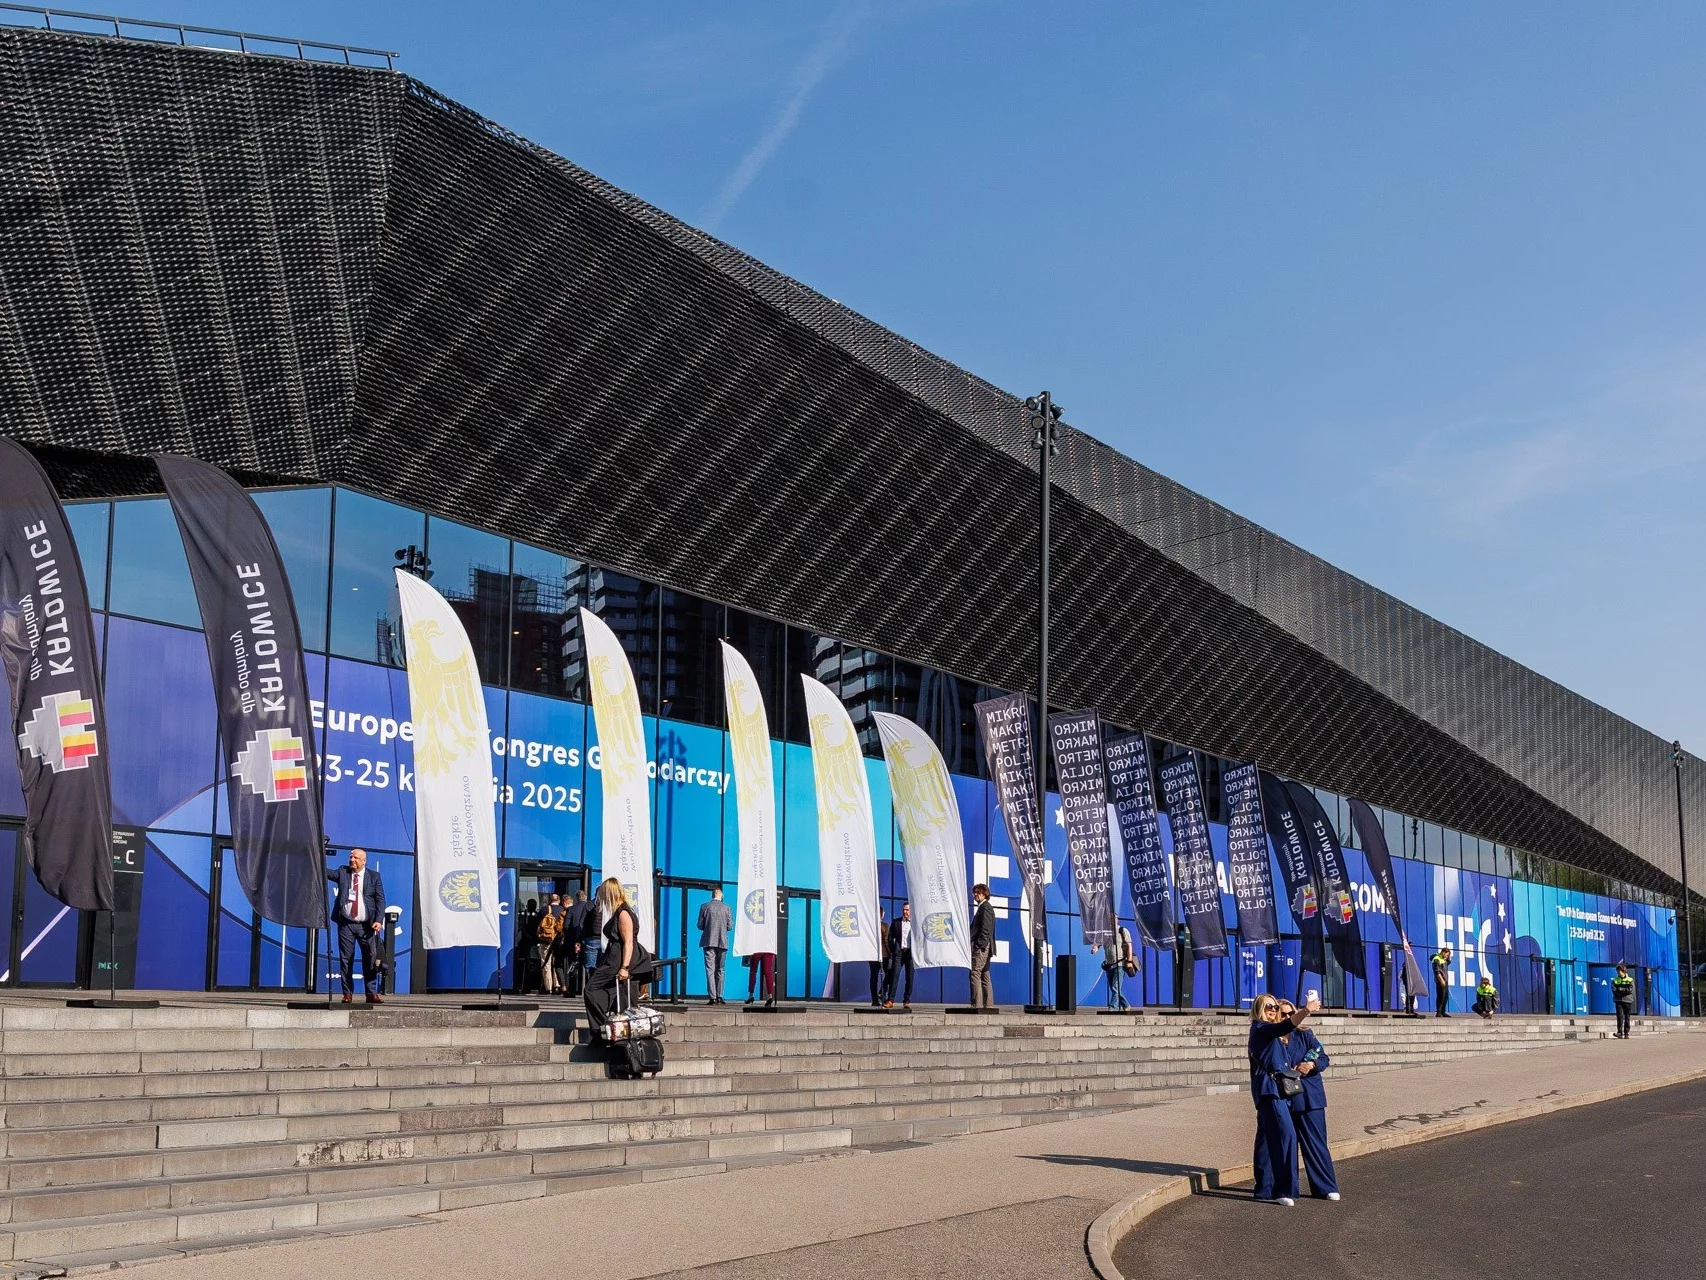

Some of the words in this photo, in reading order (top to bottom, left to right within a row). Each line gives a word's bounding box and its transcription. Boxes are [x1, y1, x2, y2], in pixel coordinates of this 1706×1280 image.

[986, 705, 1026, 723] MIKRO
[310, 700, 414, 744] Europe
[488, 730, 580, 767] ongres
[587, 746, 731, 794] Godarczy
[522, 781, 582, 813] 2025
[126, 850, 135, 864] C
[1437, 913, 1493, 987] EEC
[1256, 961, 1264, 977] B
[1287, 958, 1293, 966] B
